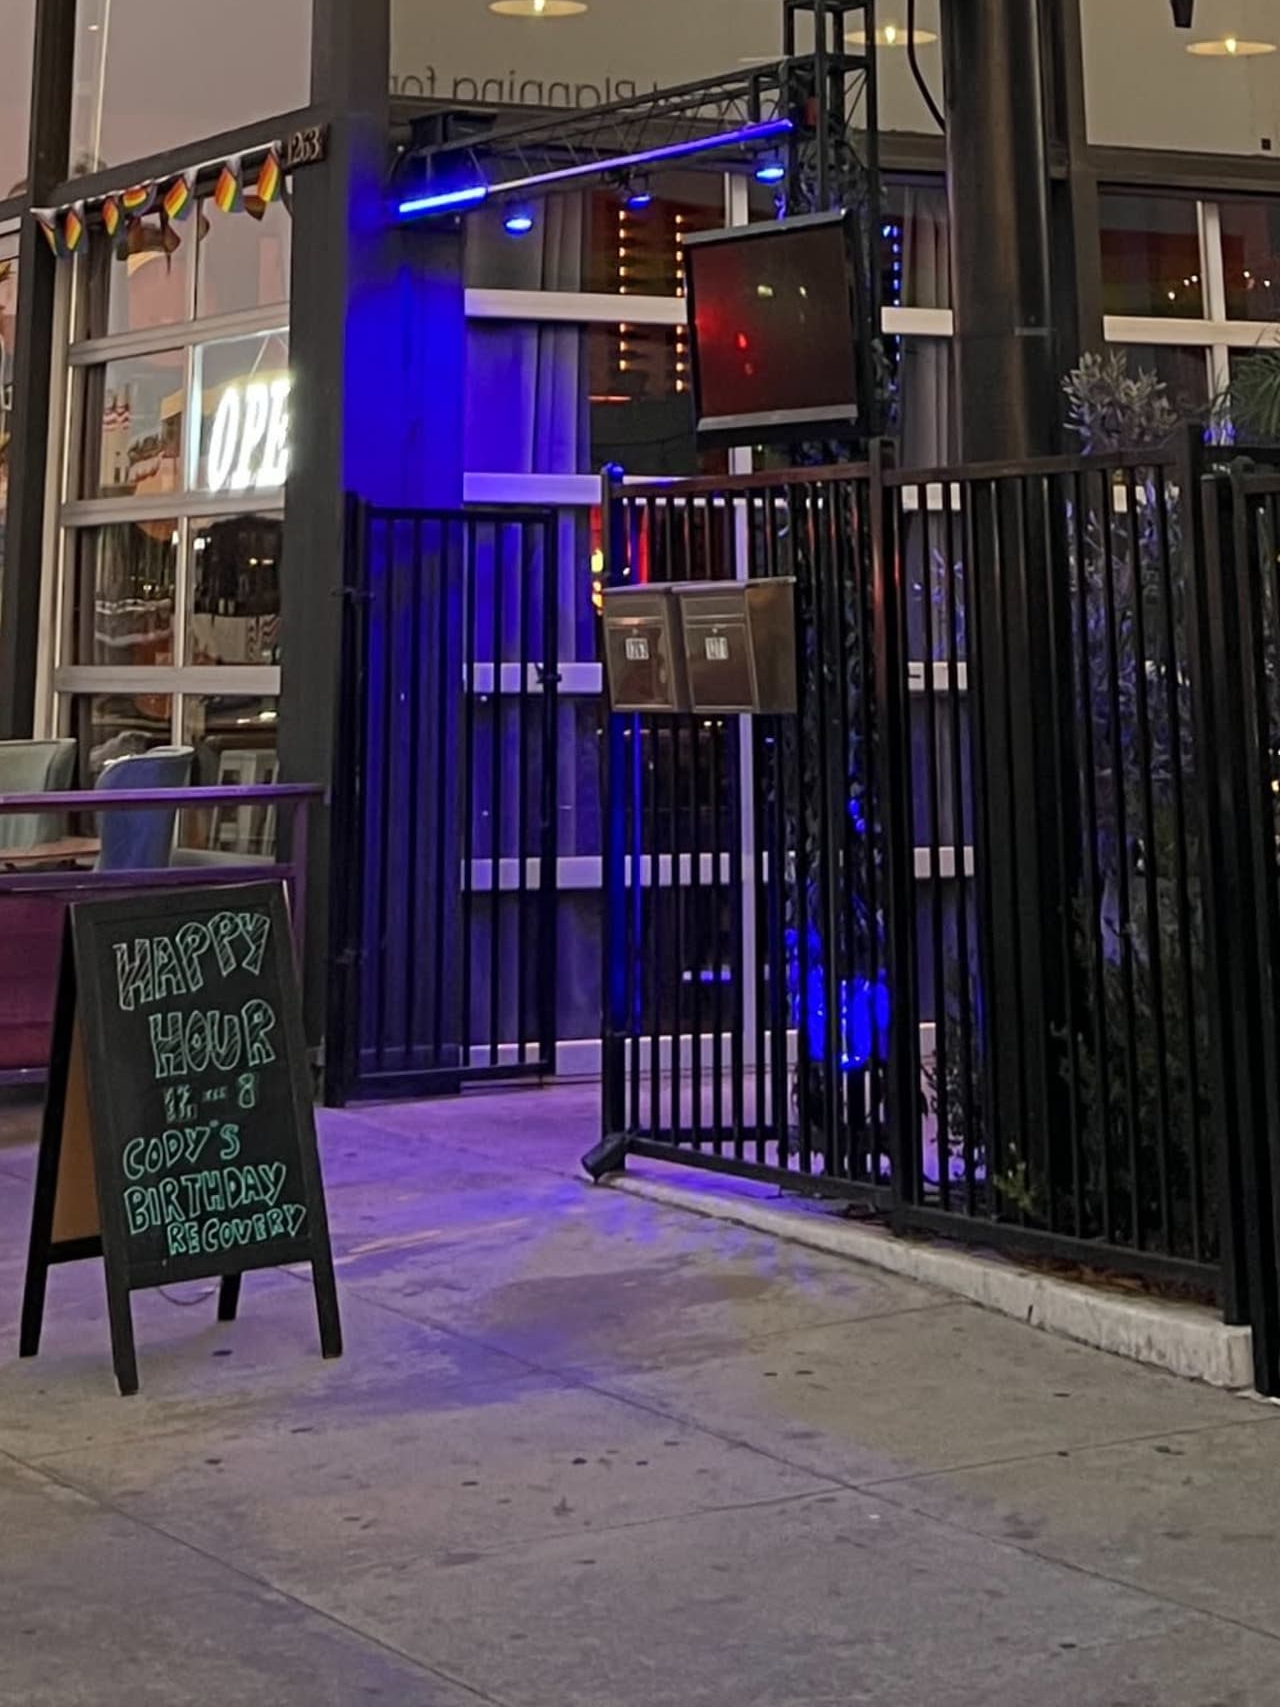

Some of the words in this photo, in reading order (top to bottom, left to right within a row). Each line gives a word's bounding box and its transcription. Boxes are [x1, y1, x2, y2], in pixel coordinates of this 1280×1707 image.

[208, 374, 291, 492] OPE
[113, 912, 270, 1010] HAPPY
[149, 999, 276, 1078] HOUR
[123, 1119, 240, 1180] CODY'S
[123, 1162, 286, 1235] BIRTHDAY
[168, 1203, 307, 1256] RECOVERY
